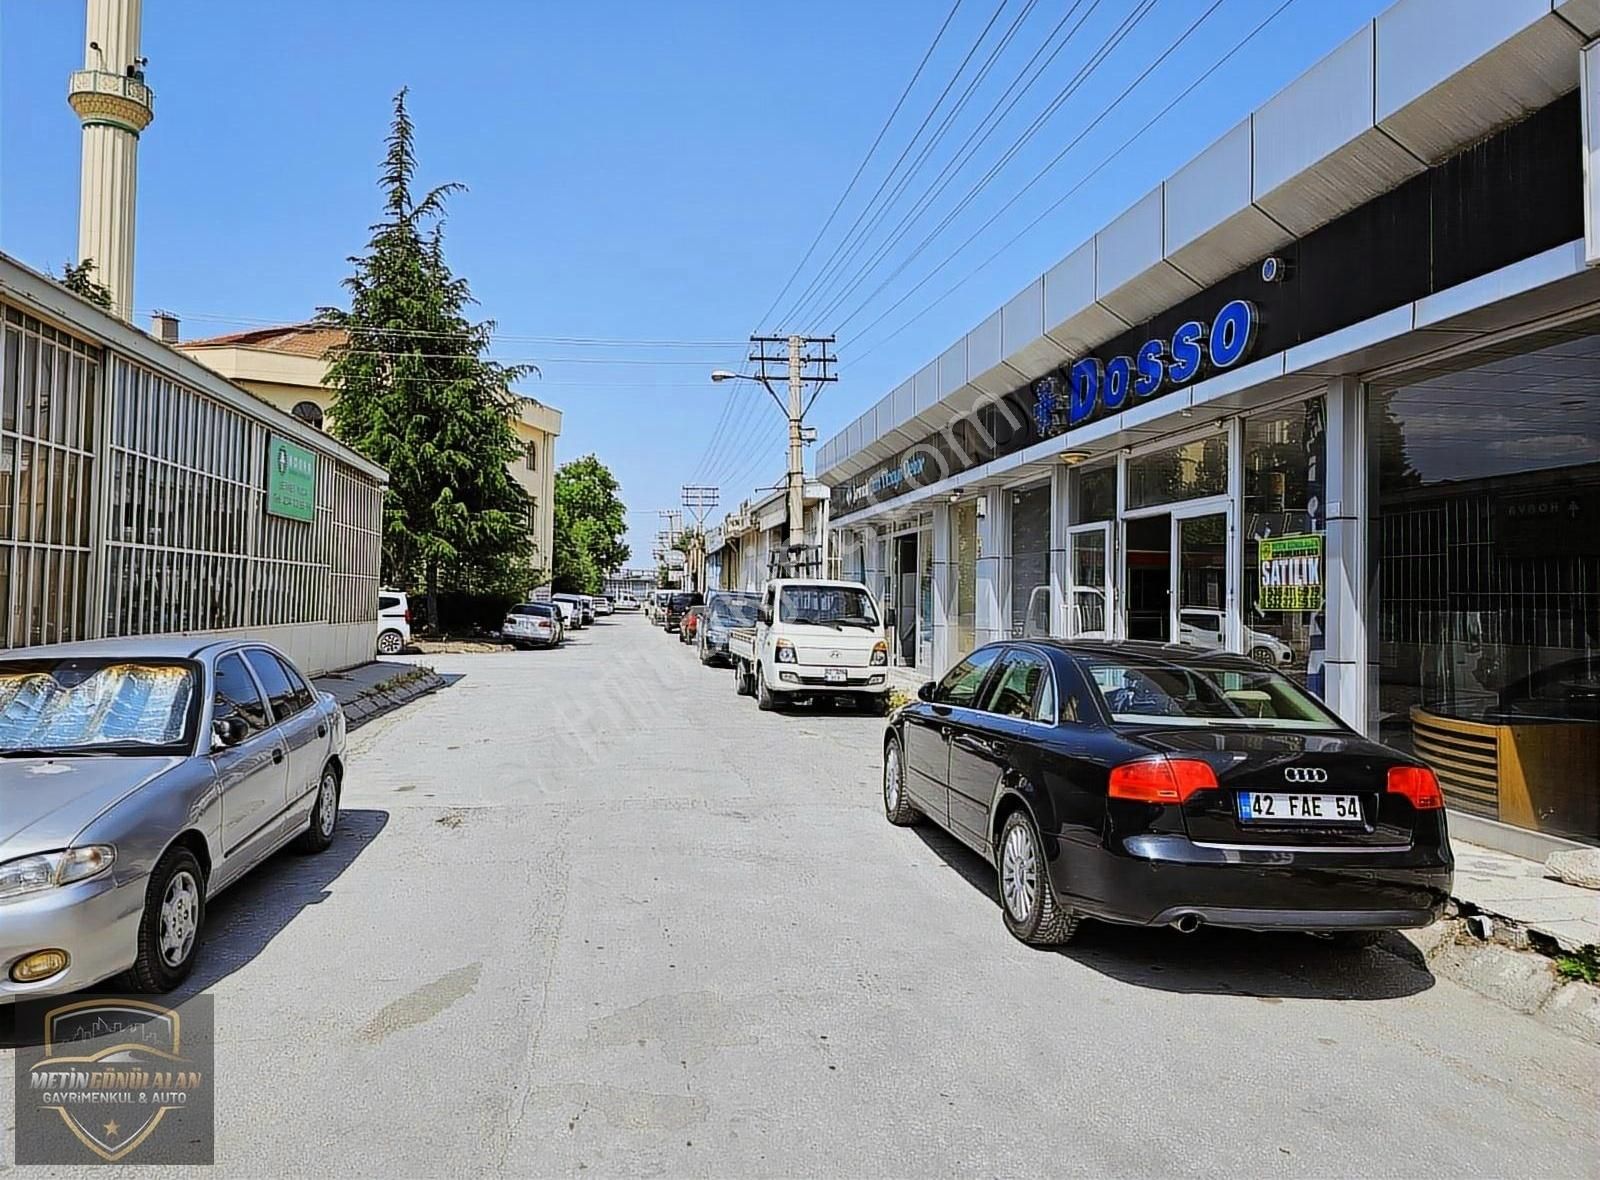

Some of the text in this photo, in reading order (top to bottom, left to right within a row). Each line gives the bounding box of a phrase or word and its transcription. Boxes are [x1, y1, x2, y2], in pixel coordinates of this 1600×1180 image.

[1262, 557, 1319, 586] SATILIK
[1252, 794, 1358, 818] 42 FAE 54
